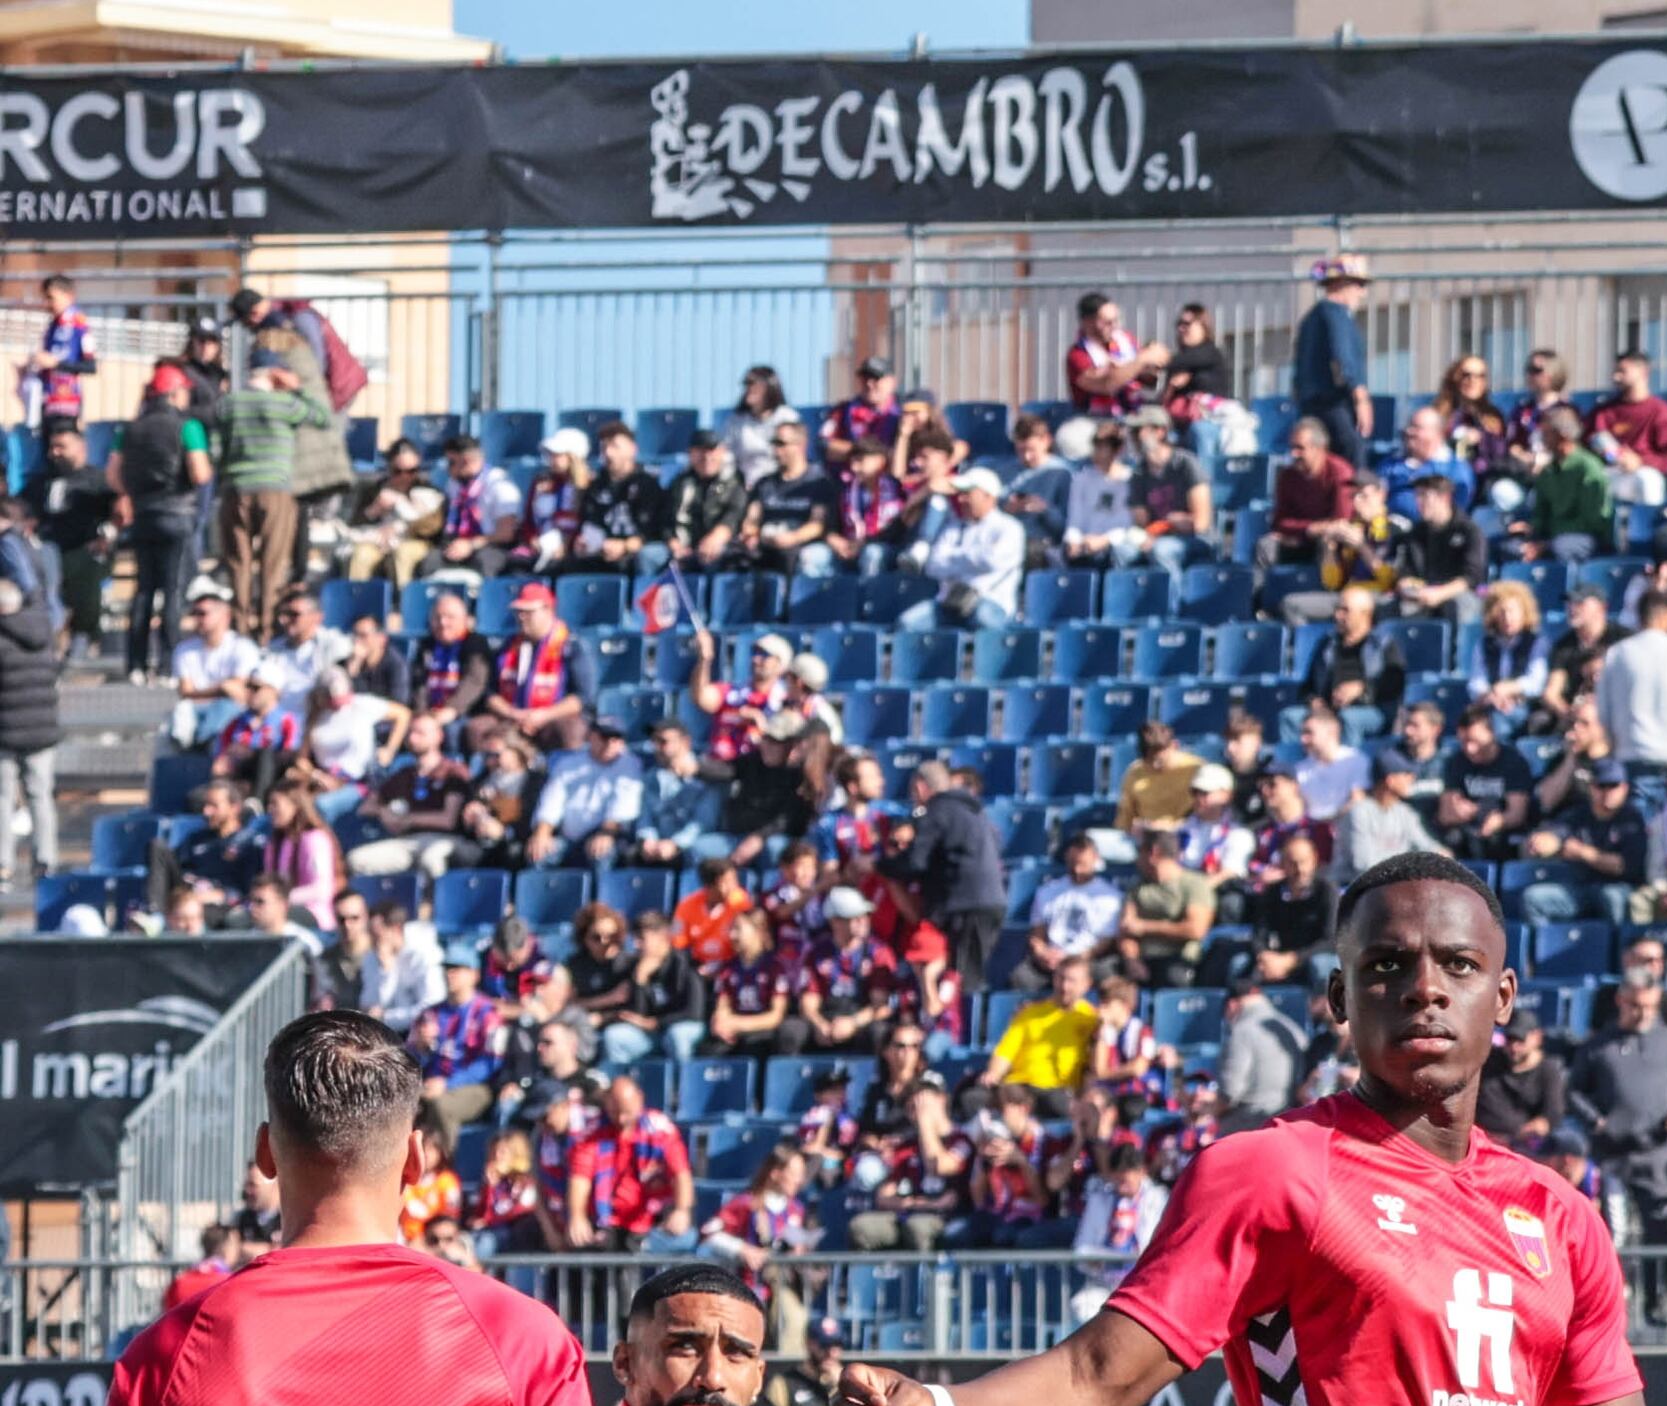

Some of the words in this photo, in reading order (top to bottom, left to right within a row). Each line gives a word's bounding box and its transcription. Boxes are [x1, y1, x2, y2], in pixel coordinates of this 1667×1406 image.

[711, 61, 1145, 196] DECAMBRO
[32, 1040, 186, 1100] mari
[1446, 1268, 1515, 1395] fi
